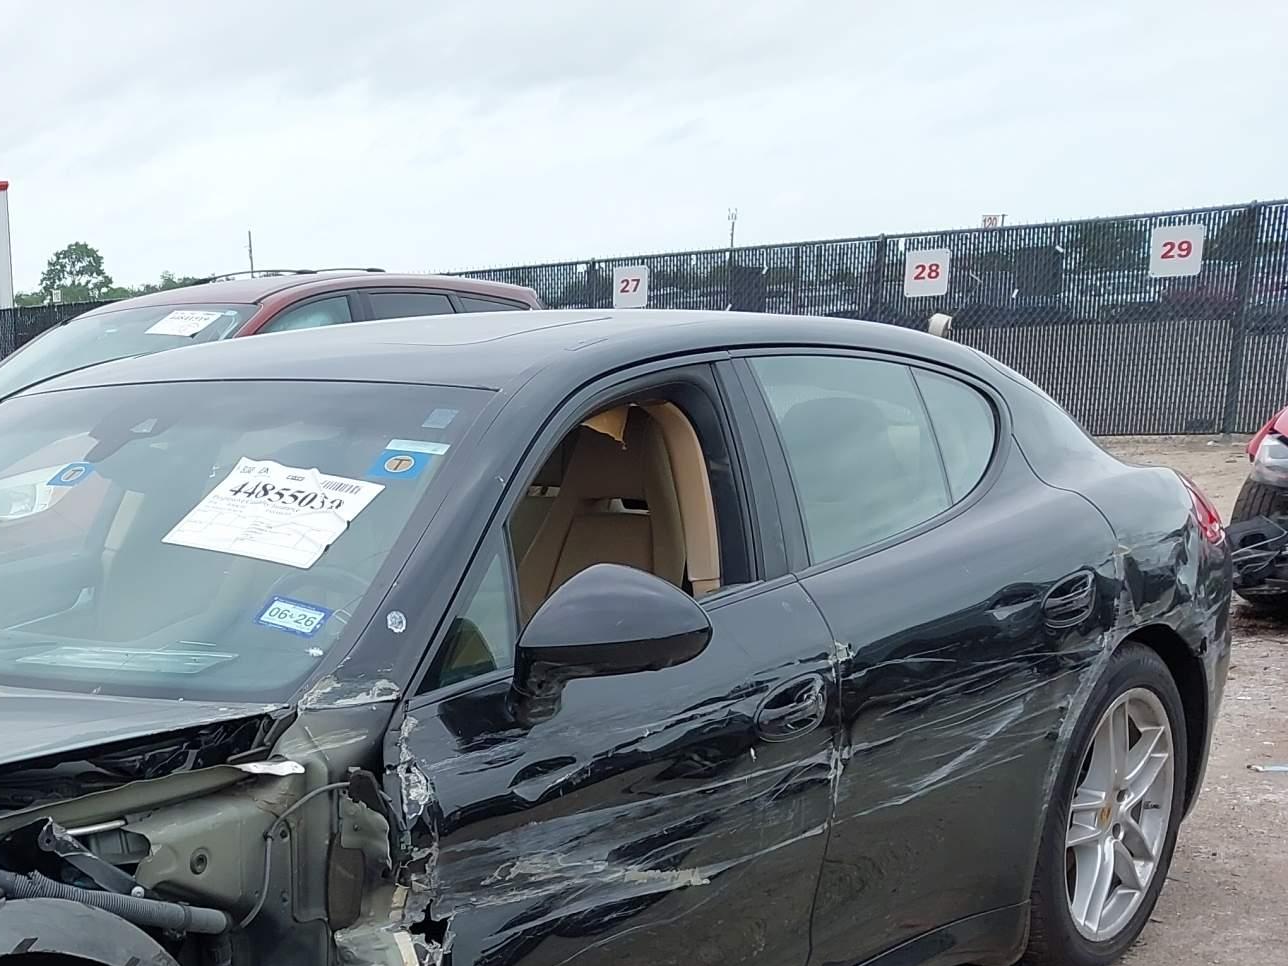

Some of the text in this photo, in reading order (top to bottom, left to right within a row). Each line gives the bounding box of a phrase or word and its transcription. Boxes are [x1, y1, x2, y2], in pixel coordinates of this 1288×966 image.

[1160, 240, 1193, 259] 29
[913, 263, 940, 280] 28
[619, 278, 641, 293] 27
